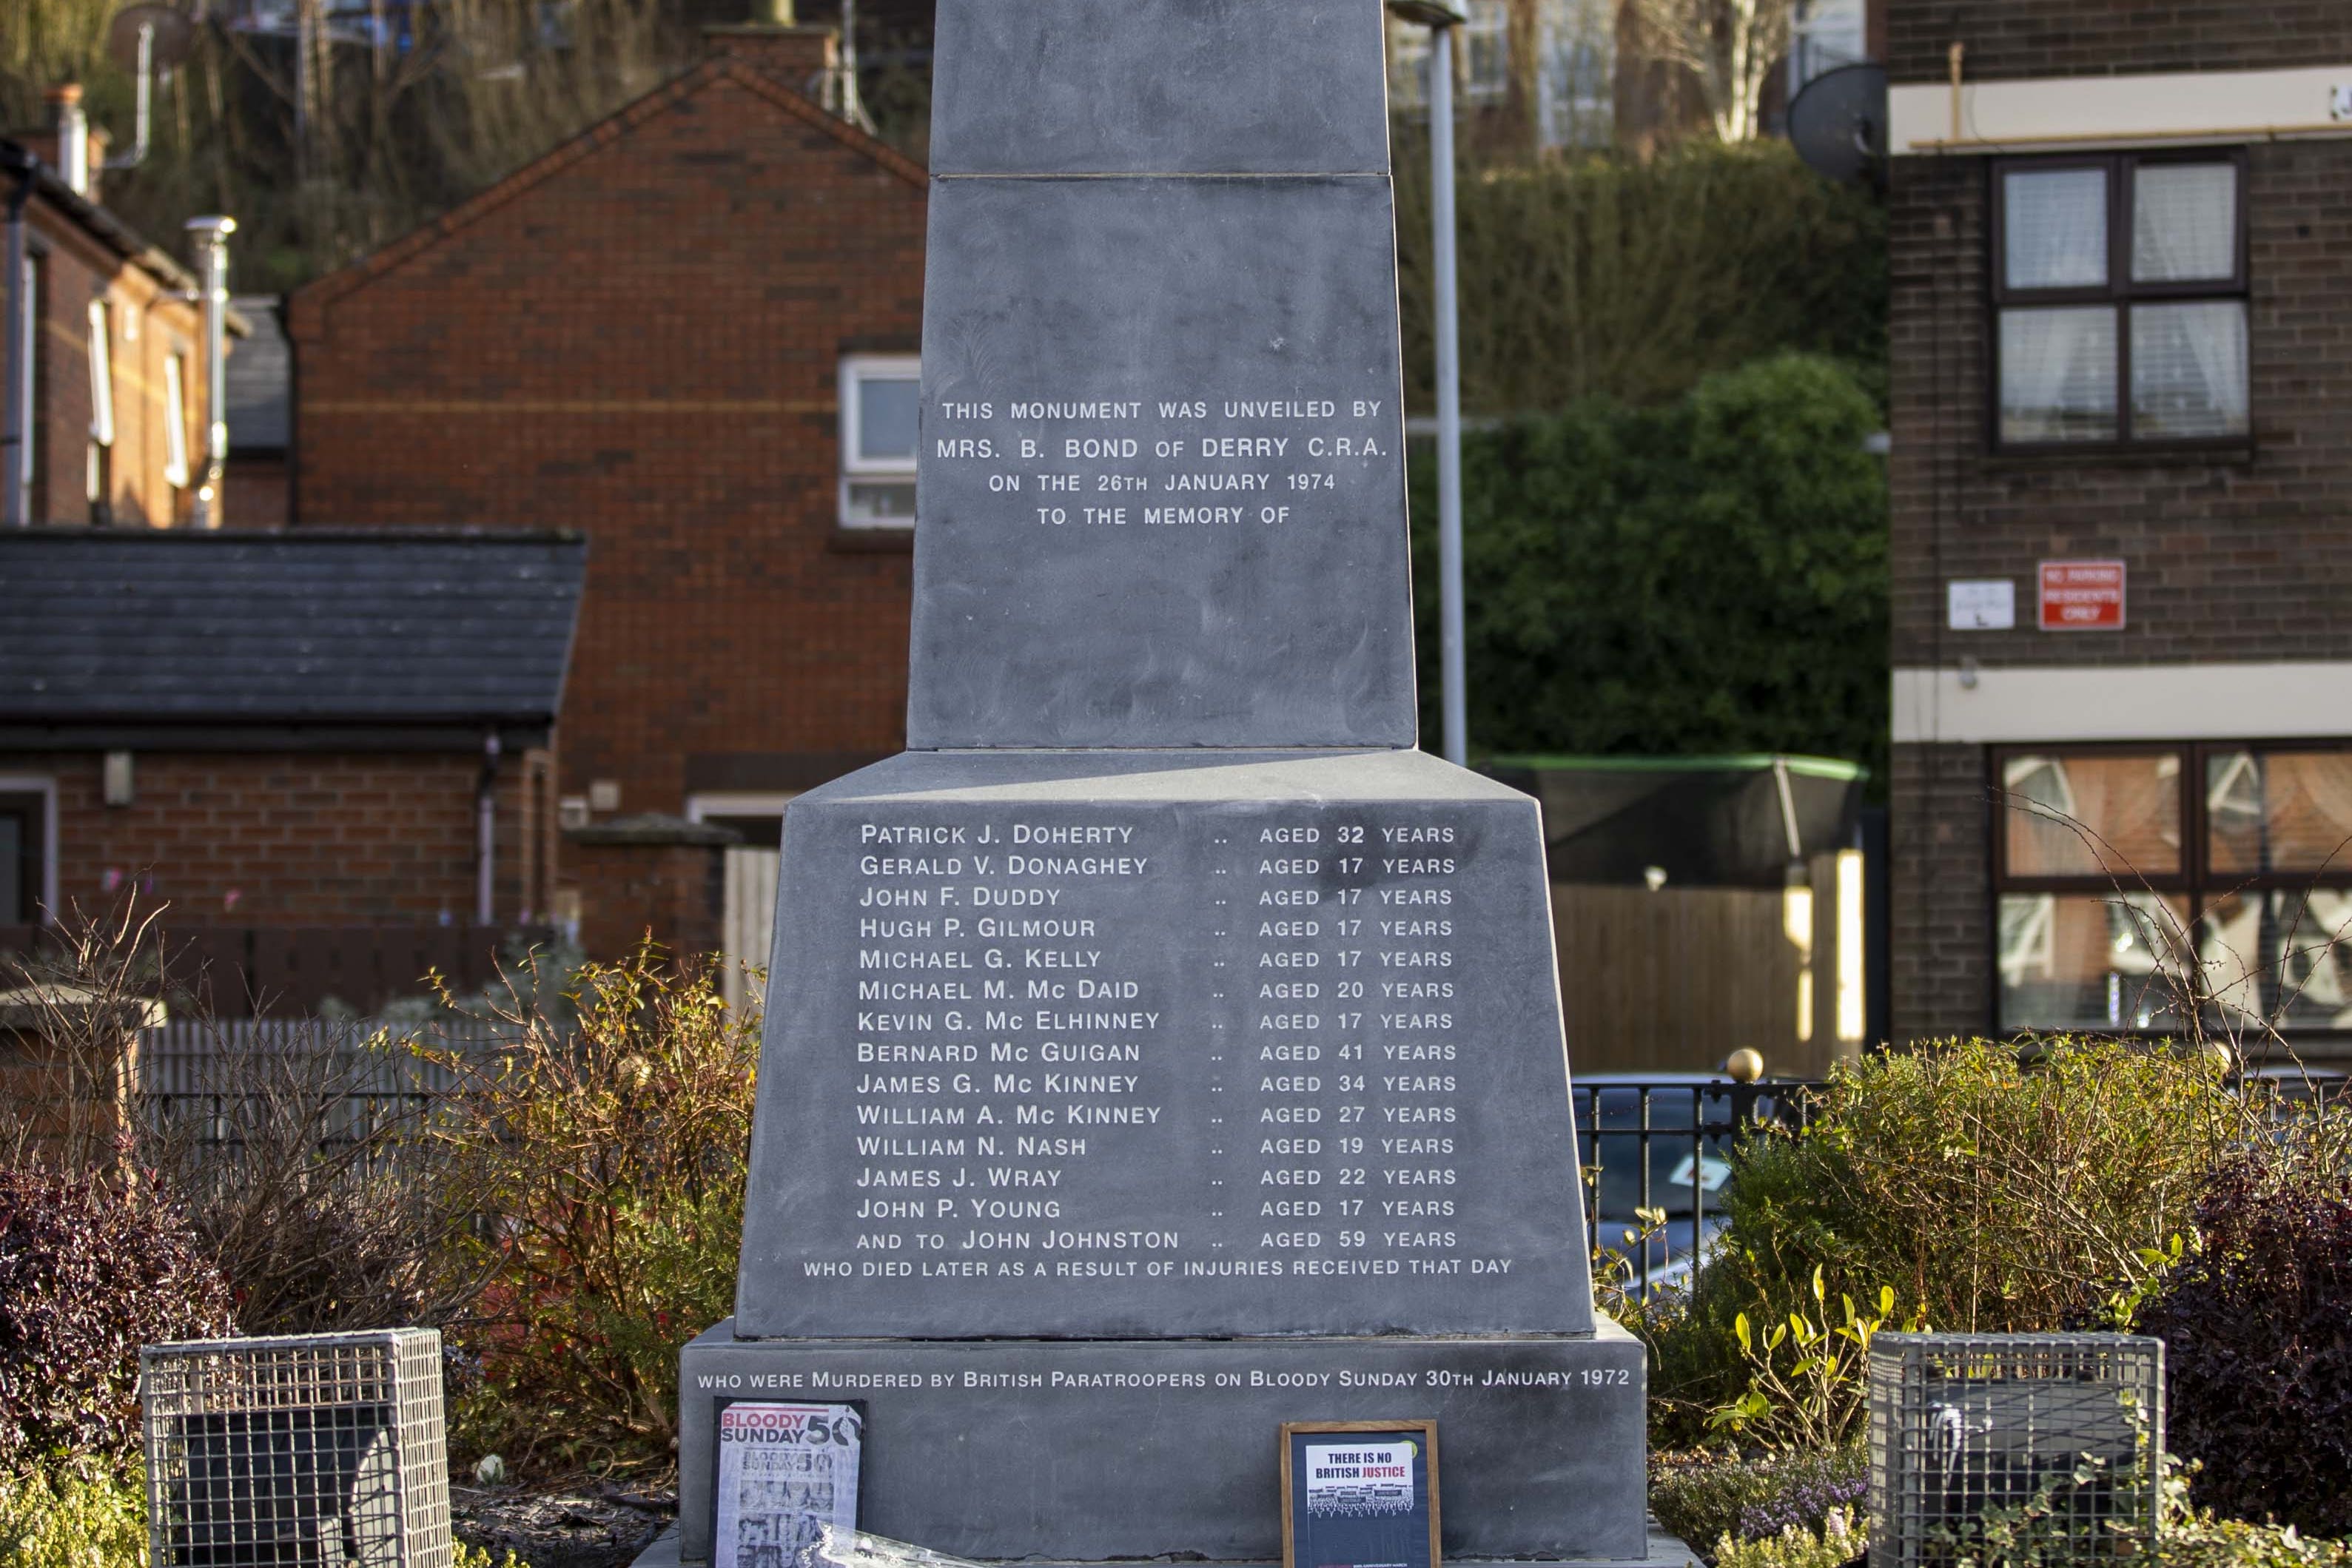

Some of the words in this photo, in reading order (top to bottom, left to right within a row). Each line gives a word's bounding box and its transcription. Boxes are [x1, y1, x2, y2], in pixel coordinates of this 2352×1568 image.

[941, 402, 993, 420] THIS
[1010, 402, 1142, 420] MONUMENT
[1158, 401, 1207, 419] WAS
[1224, 400, 1335, 418] UNVEILED
[1353, 400, 1381, 417] BY
[937, 438, 1000, 459] MRS.
[1021, 439, 1044, 458] B.
[1065, 438, 1138, 459] BOND
[1155, 440, 1184, 458] OF
[1202, 437, 1289, 457] DERRY
[1308, 437, 1387, 457] C.R.A.
[989, 474, 1020, 492] ON
[1037, 474, 1081, 491] THE
[1098, 474, 1147, 491] 26TH
[1164, 473, 1270, 491] JANUARY
[1287, 473, 1335, 491] 1974
[1036, 508, 1066, 525] TO
[1083, 508, 1126, 525] THE
[1144, 506, 1243, 525] MEMORY
[1260, 505, 1290, 525] OF
[861, 824, 966, 844] PATRICK
[977, 824, 1000, 844] J.
[1013, 824, 1133, 844] DOHERTY
[1260, 827, 1320, 844] AGED
[1337, 825, 1365, 844] 32
[1381, 827, 1454, 844] YEARS
[860, 855, 962, 875] GERALD
[973, 855, 995, 875] V.
[1008, 855, 1148, 875] DONAGHEY
[1259, 858, 1320, 875] AGED
[1339, 857, 1364, 875] 17
[1382, 858, 1455, 874] YEARS
[859, 886, 927, 907] JOHN
[940, 886, 960, 906] F.
[973, 886, 1061, 906] DUDDY
[1259, 889, 1320, 906] AGED
[1337, 888, 1362, 905] 17
[1380, 889, 1452, 905] YEARS
[860, 918, 931, 938] HUGH
[944, 918, 965, 938] P.
[978, 917, 1095, 938] GILMOUR
[1259, 921, 1320, 937] AGED
[1337, 919, 1362, 936] 17
[1380, 920, 1453, 937] YEARS
[859, 949, 973, 969] MICHAEL
[984, 948, 1012, 969] G.
[1025, 948, 1101, 969] KELLY
[1259, 952, 1320, 968] AGED
[1337, 950, 1362, 967] 17
[1380, 951, 1452, 967] YEARS
[859, 980, 972, 1000] MICHAEL
[984, 980, 1015, 1000] M.
[1078, 979, 1139, 999] DAID
[1259, 983, 1320, 999] AGED
[1337, 981, 1364, 998] 20
[1381, 982, 1454, 998] YEARS
[858, 1012, 932, 1032] KEVIN
[944, 1010, 972, 1032] G.
[1036, 1010, 1160, 1030] ELHINNEY
[1259, 1014, 1320, 1030] AGED
[1338, 1012, 1363, 1029] 17
[1380, 1013, 1453, 1029] YEARS
[857, 1042, 978, 1063] BERNARD
[1041, 1041, 1140, 1063] GUIGAN
[1260, 1045, 1321, 1061] AGED
[1338, 1043, 1362, 1060] 41
[1383, 1044, 1456, 1060] YEARS
[856, 1073, 941, 1094] JAMES
[952, 1073, 981, 1094] G.
[1044, 1073, 1138, 1094] KINNEY
[1260, 1076, 1321, 1092] AGED
[1339, 1074, 1365, 1092] 34
[1382, 1075, 1456, 1092] YEARS
[856, 1105, 964, 1125] WILLIAM
[976, 1105, 1004, 1125] A.
[1067, 1104, 1161, 1124] KINNEY
[1260, 1107, 1321, 1123] AGED
[1339, 1106, 1365, 1123] 27
[1382, 1106, 1456, 1123] YEARS
[856, 1136, 965, 1156] WILLIAM
[978, 1136, 1004, 1156] N.
[1018, 1136, 1086, 1156] NASH
[1260, 1138, 1321, 1154] AGED
[1339, 1137, 1364, 1154] 19
[1381, 1138, 1454, 1154] YEARS
[856, 1167, 941, 1188] JAMES
[952, 1167, 975, 1188] J.
[987, 1167, 1061, 1187] WRAY
[1260, 1169, 1321, 1185] AGED
[1339, 1168, 1365, 1185] 22
[1383, 1168, 1456, 1185] YEARS
[856, 1198, 924, 1219] JOHN
[937, 1198, 958, 1218] P.
[970, 1198, 1061, 1219] YOUNG
[1260, 1200, 1321, 1217] AGED
[1339, 1199, 1364, 1217] 17
[1382, 1200, 1455, 1217] YEARS
[856, 1234, 902, 1249] AND
[915, 1234, 944, 1250] TO
[961, 1229, 1030, 1250] JOHN
[1041, 1229, 1178, 1250] JOHNSTON
[1260, 1231, 1321, 1248] AGED
[1339, 1230, 1366, 1248] 59
[1383, 1231, 1456, 1248] YEARS
[803, 1261, 853, 1277] WHO
[862, 1261, 913, 1276] DIED
[922, 1262, 988, 1276] LATER
[997, 1262, 1025, 1276] AS
[1033, 1262, 1047, 1276] A
[1056, 1261, 1138, 1276] RESULT
[1146, 1261, 1175, 1276] OF
[1184, 1260, 1283, 1276] INJURIES
[1293, 1259, 1400, 1276] RECEIVED
[1408, 1259, 1462, 1274] THAT
[1471, 1259, 1512, 1274] DAY
[697, 1374, 742, 1389] WHO
[749, 1373, 804, 1388] WERE
[812, 1371, 923, 1388] MURDERED
[930, 1373, 955, 1387] BY
[964, 1370, 1042, 1387] BRITISH
[1051, 1370, 1206, 1387] PARATROOPERS
[1214, 1373, 1241, 1387] ON
[1250, 1370, 1331, 1387] BLOODY
[1339, 1370, 1418, 1387] SUNDAY
[1425, 1370, 1474, 1387] 30TH
[1481, 1369, 1572, 1387] JANUARY
[1580, 1368, 1630, 1386] 1972
[722, 1413, 805, 1429] BLOODY
[722, 1427, 805, 1444] SUNDAY
[742, 1461, 796, 1471] SUNDAY
[1328, 1453, 1361, 1464] THERE
[1364, 1452, 1374, 1464] IS
[1377, 1452, 1392, 1464] NO
[1315, 1467, 1360, 1478] BRITISH
[1362, 1466, 1405, 1478] JUSTICE
